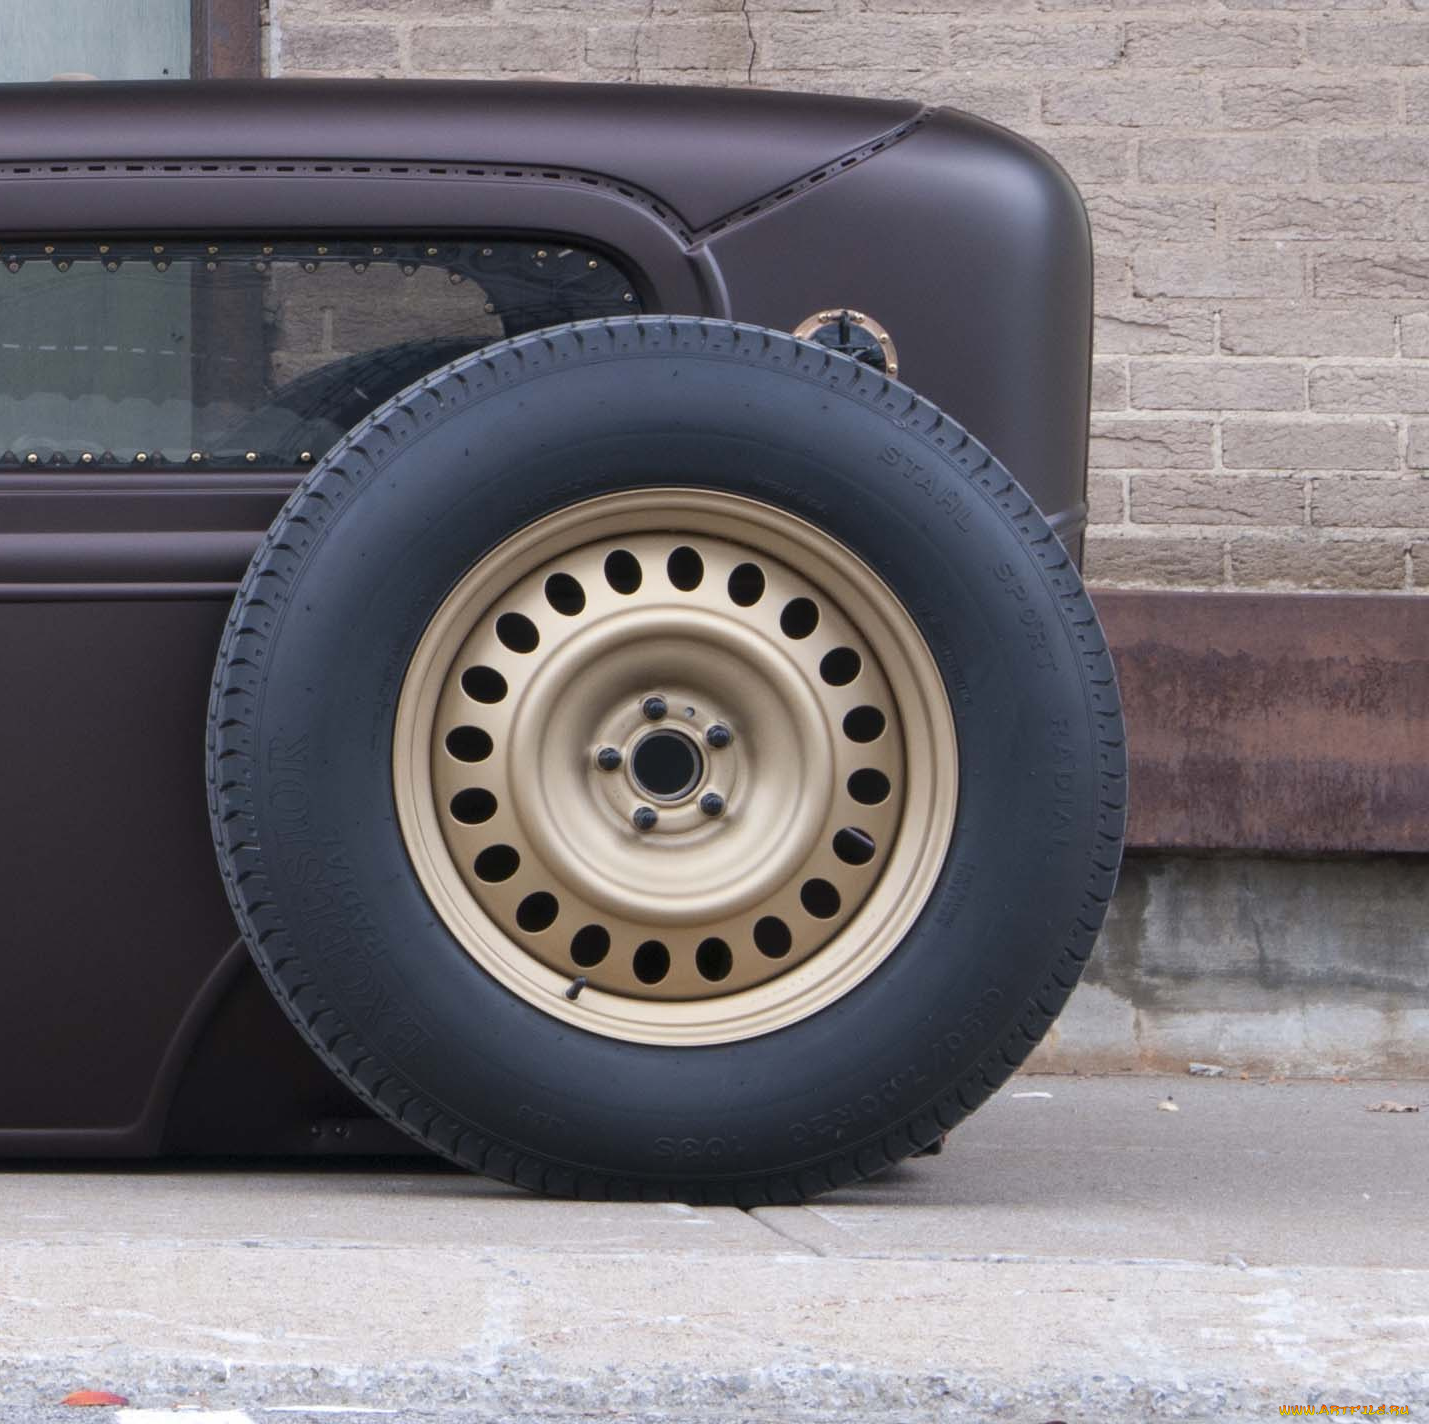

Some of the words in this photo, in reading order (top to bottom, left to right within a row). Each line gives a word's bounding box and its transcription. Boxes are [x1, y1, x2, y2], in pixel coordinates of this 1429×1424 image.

[878, 445, 973, 534] STAHL
[990, 562, 1058, 672] SPORT
[1051, 719, 1078, 848] RADIAL
